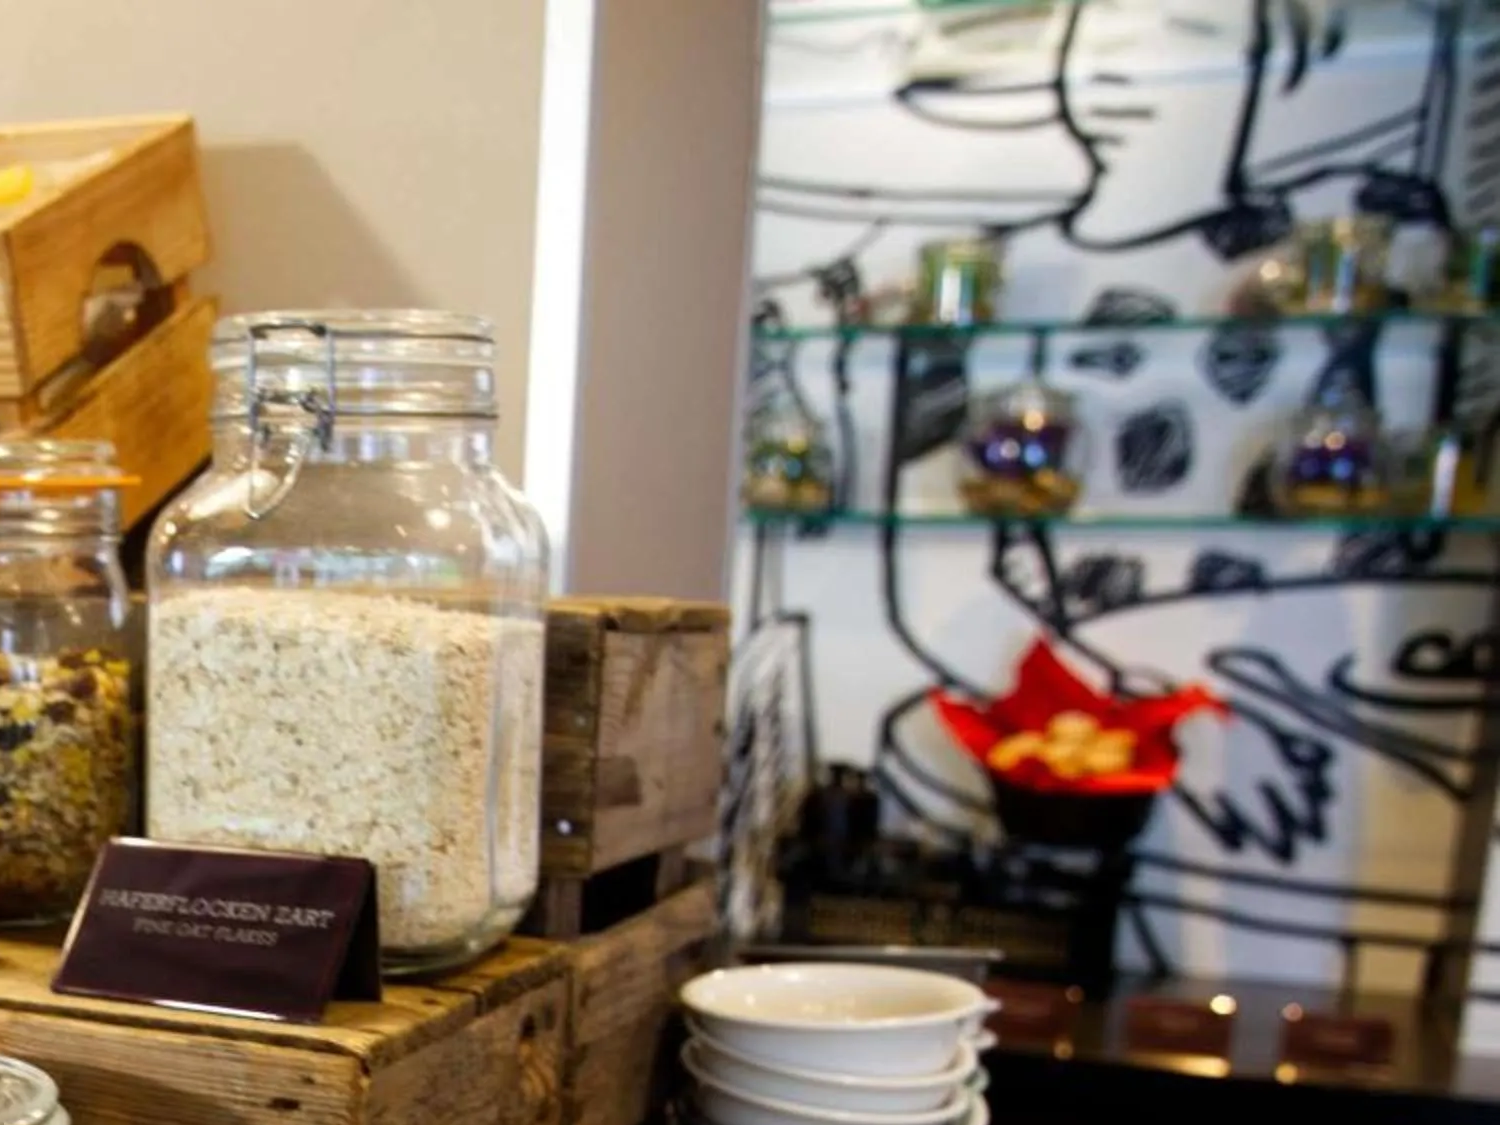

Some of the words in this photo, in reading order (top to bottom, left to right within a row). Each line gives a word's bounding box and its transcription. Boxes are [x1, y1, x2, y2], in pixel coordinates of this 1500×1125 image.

[97, 887, 272, 922] HAFERFLOCKEN
[273, 903, 336, 929] ZART
[132, 917, 171, 935] FINE
[175, 920, 213, 939] OAT
[214, 927, 280, 947] FLAKES
